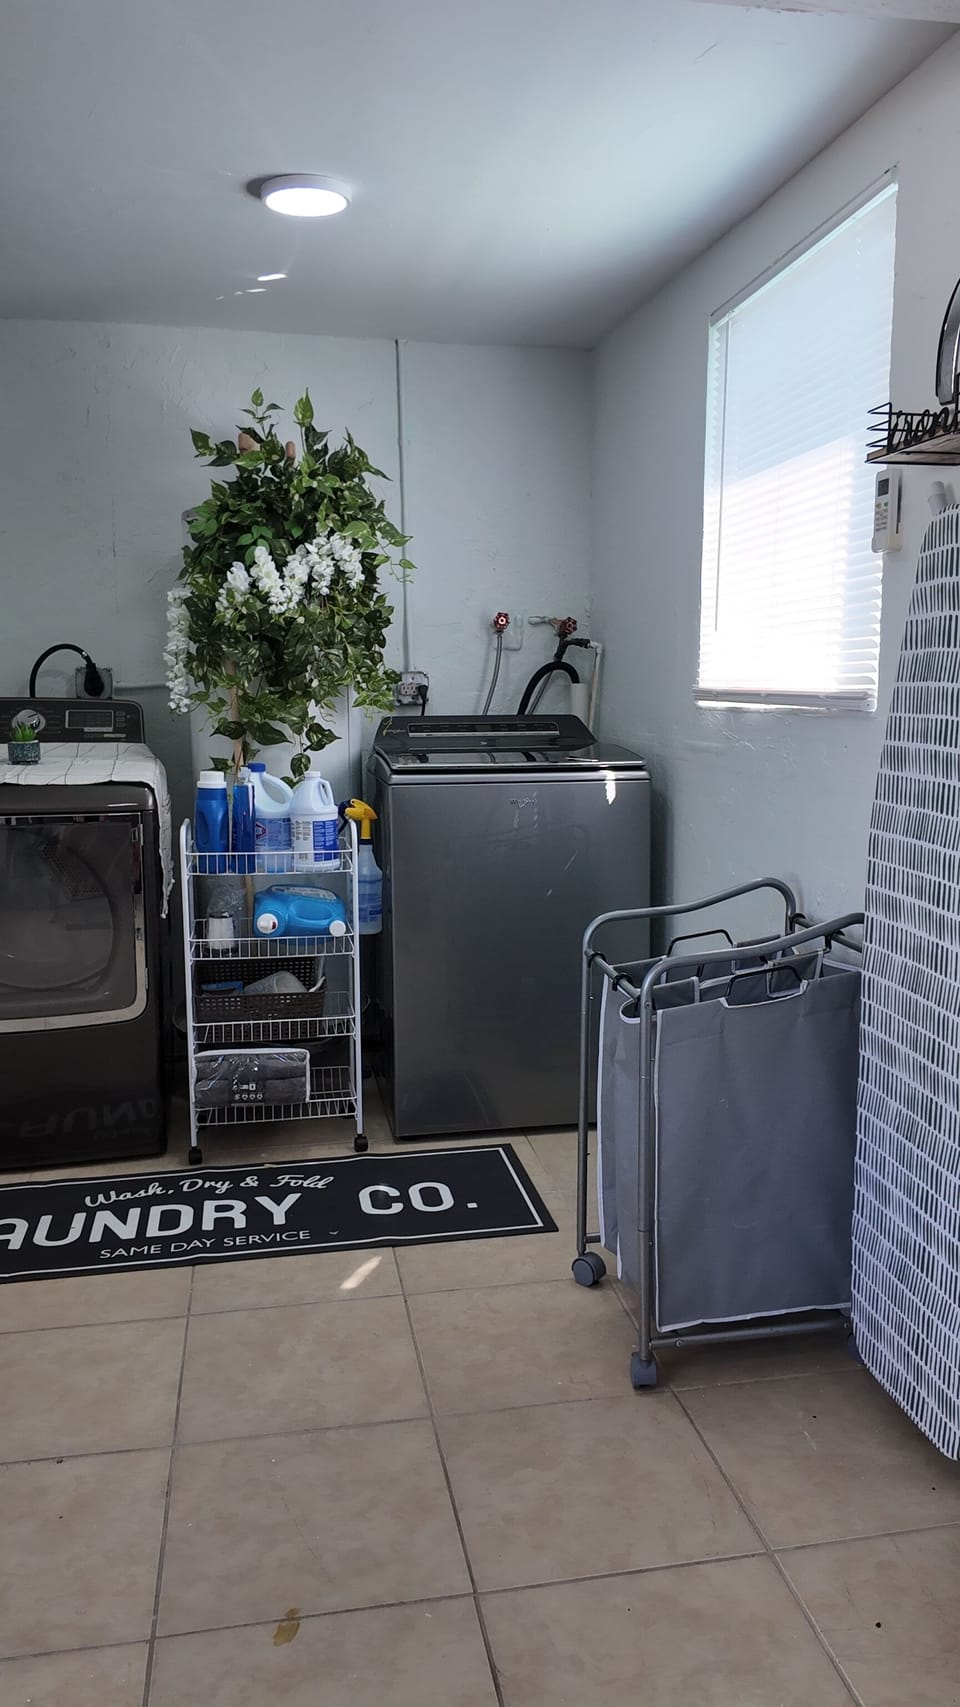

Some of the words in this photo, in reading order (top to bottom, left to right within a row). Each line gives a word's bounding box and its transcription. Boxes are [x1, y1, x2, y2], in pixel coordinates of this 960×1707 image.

[179, 1178, 234, 1194] Dry
[239, 1175, 260, 1187] &
[269, 1174, 335, 1189] Fold
[0, 1192, 303, 1250] AUNDRY
[358, 1181, 478, 1215] CO.
[99, 1244, 162, 1259] SAME
[170, 1238, 216, 1252] DAY
[223, 1230, 311, 1247] SERVICE
